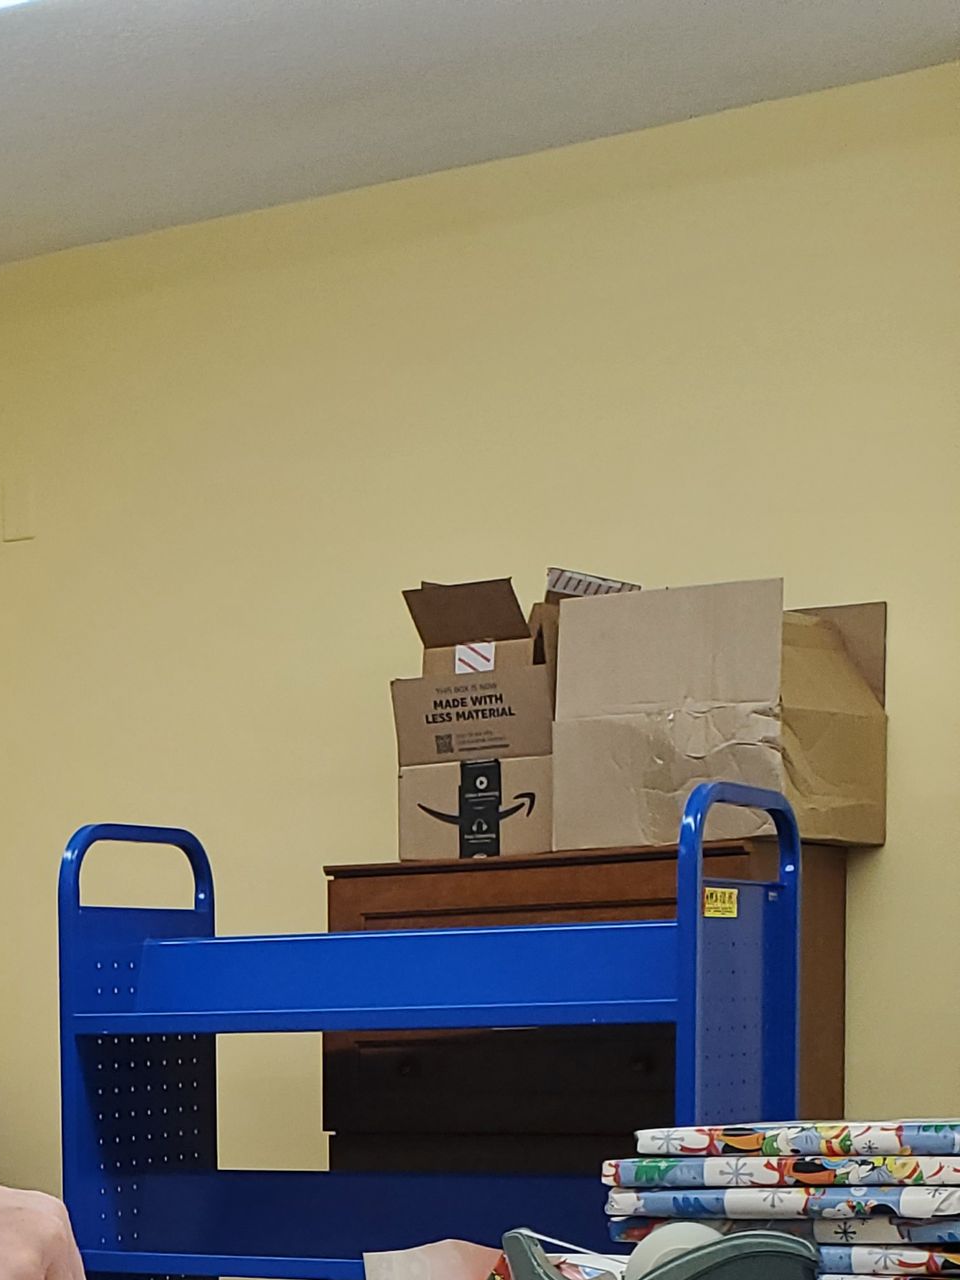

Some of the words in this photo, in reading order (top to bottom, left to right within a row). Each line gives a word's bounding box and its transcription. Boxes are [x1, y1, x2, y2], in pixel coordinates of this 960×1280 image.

[433, 697, 468, 710] MADE
[470, 693, 503, 706] WITH
[425, 712, 452, 724] LESS
[456, 706, 515, 722] MATERIAL
